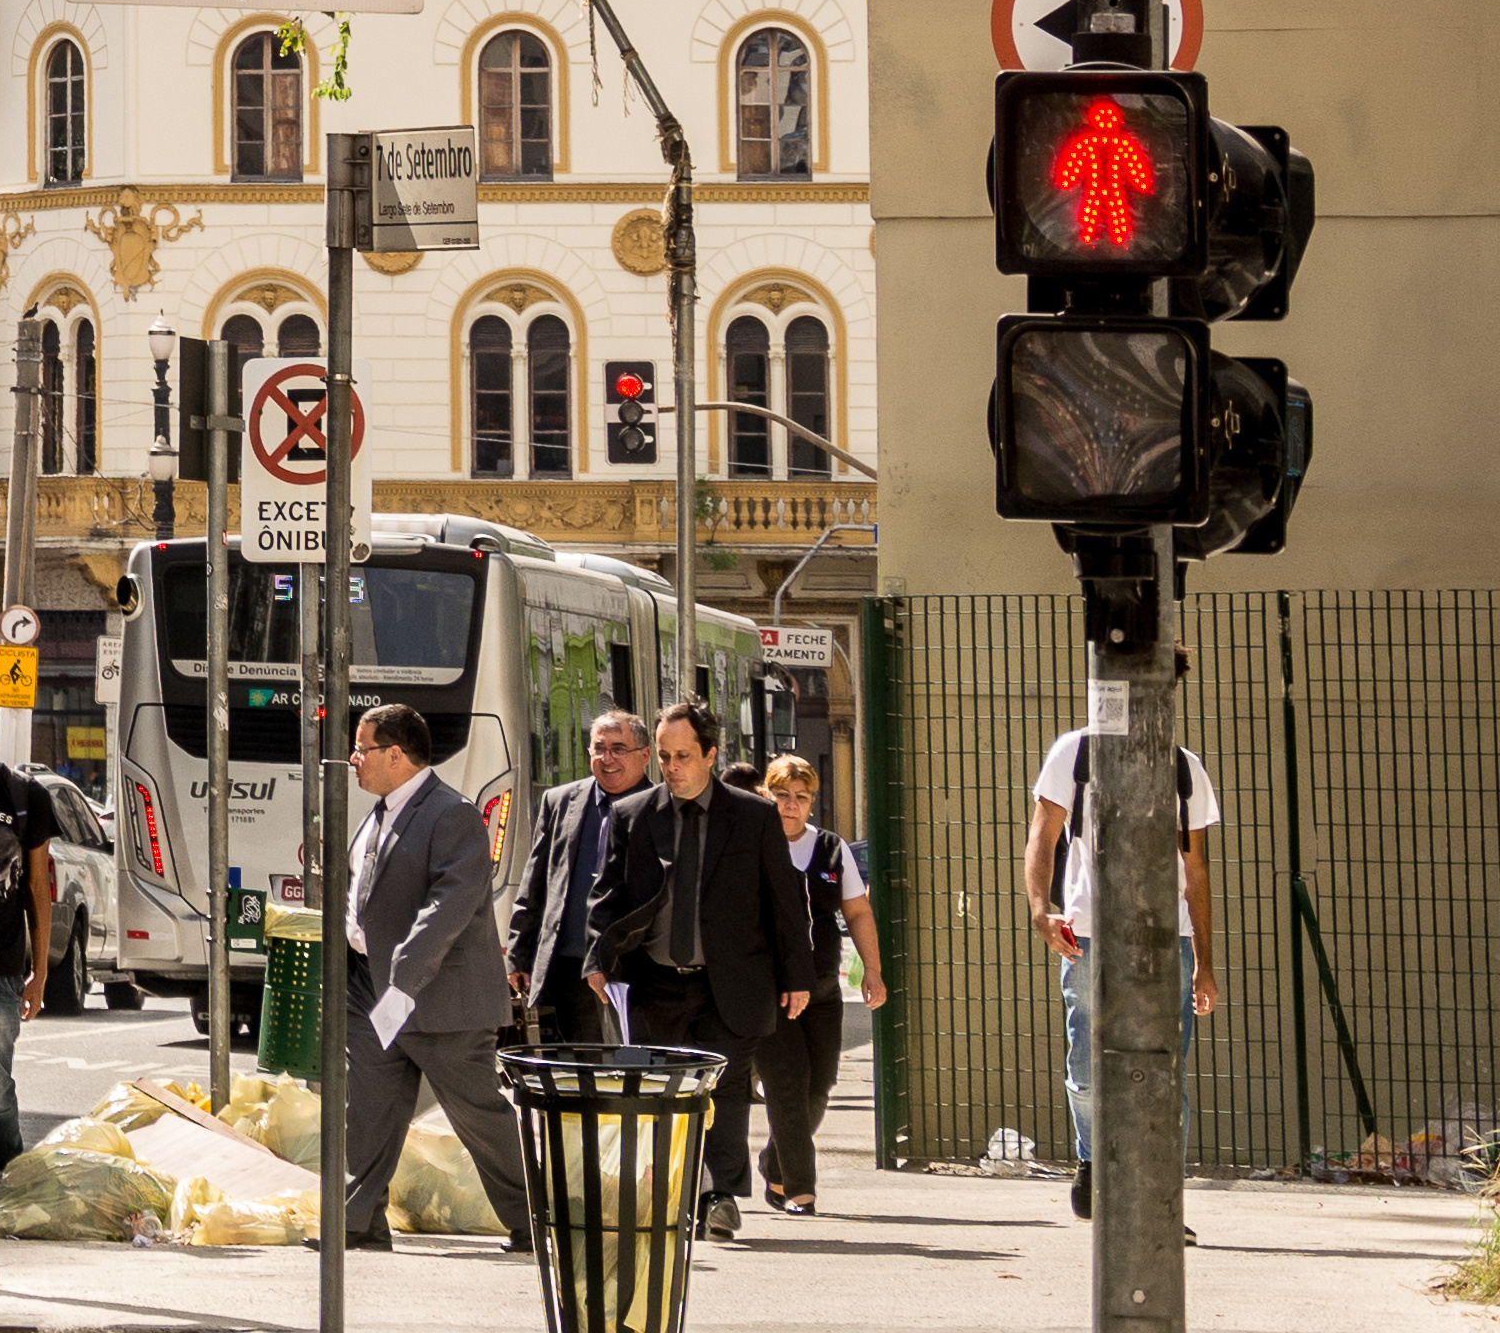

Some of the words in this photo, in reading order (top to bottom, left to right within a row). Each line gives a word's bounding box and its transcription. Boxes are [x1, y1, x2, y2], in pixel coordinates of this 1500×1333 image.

[376, 144, 383, 181] 7
[387, 141, 402, 181] de
[406, 137, 472, 181] Setembro
[378, 202, 397, 219] Largo
[397, 201, 411, 216] Sete
[413, 202, 421, 216] de
[422, 200, 455, 215] Setembro
[257, 501, 354, 522] EXCE
[257, 524, 354, 551] ÔNIB
[787, 634, 827, 645] FECHE
[239, 664, 297, 676] Denúncia
[271, 693, 288, 704] AR
